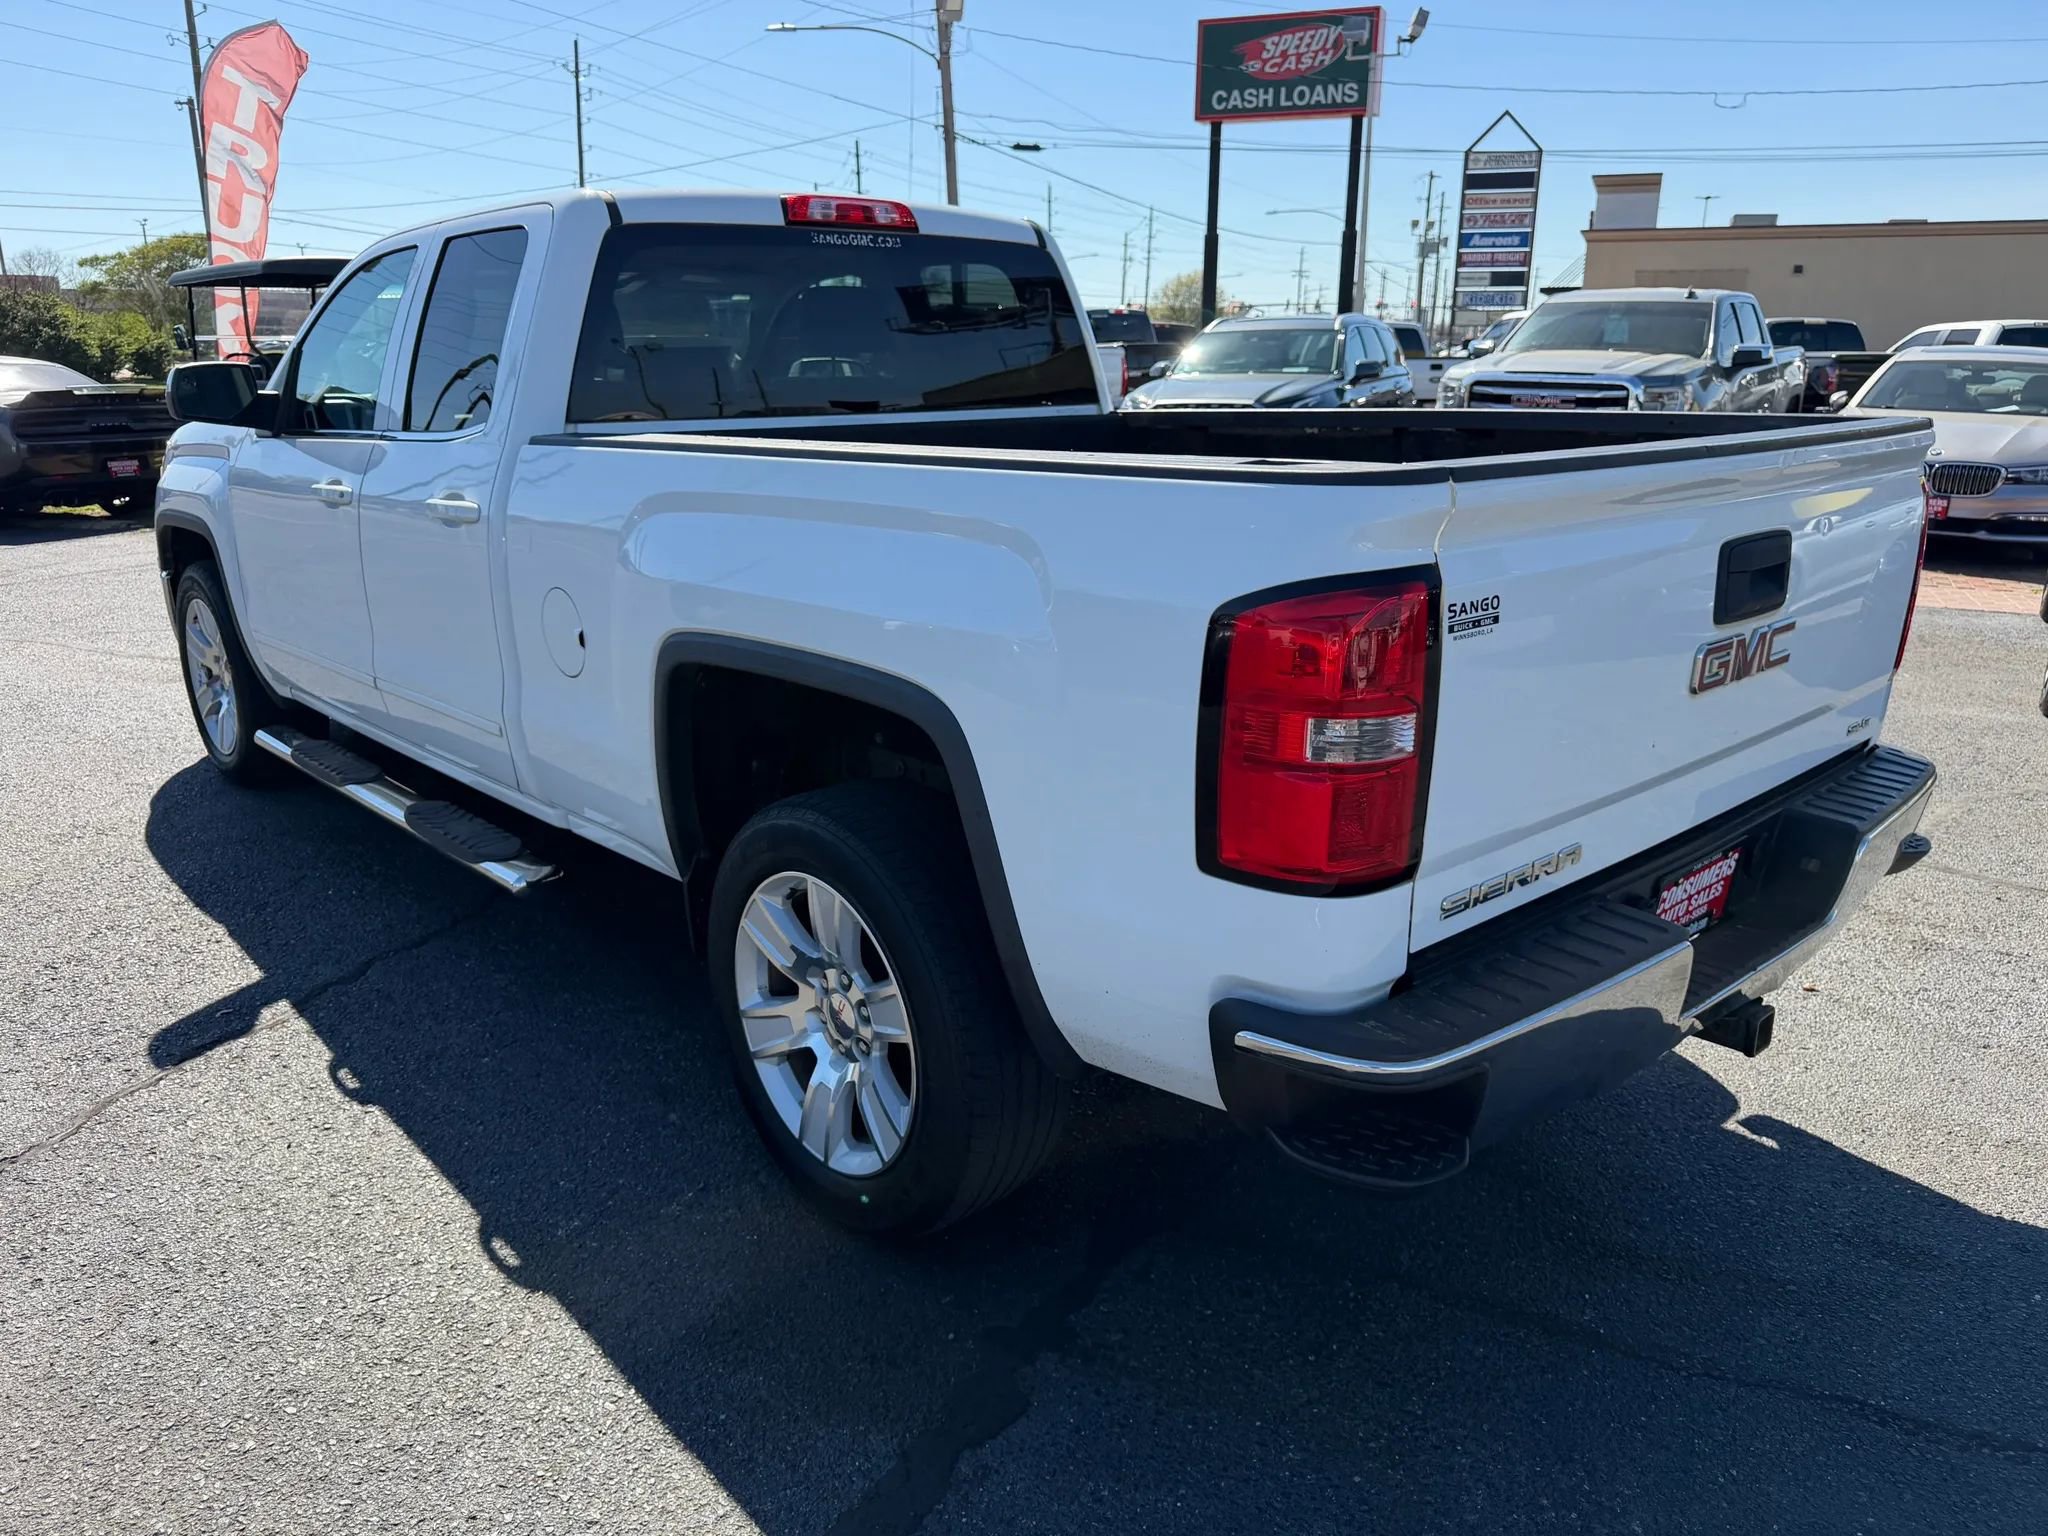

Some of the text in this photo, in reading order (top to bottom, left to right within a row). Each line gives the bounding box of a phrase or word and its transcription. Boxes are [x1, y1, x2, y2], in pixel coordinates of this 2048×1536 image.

[1261, 25, 1344, 59] SPEEDY
[1211, 82, 1360, 110] CASH LOANS
[1447, 594, 1500, 620] SANGO
[1453, 617, 1495, 632] BUICK GMC
[1689, 616, 1796, 695] GMC
[1440, 841, 1583, 921] SIERRA
[1689, 881, 1724, 911] SALES
